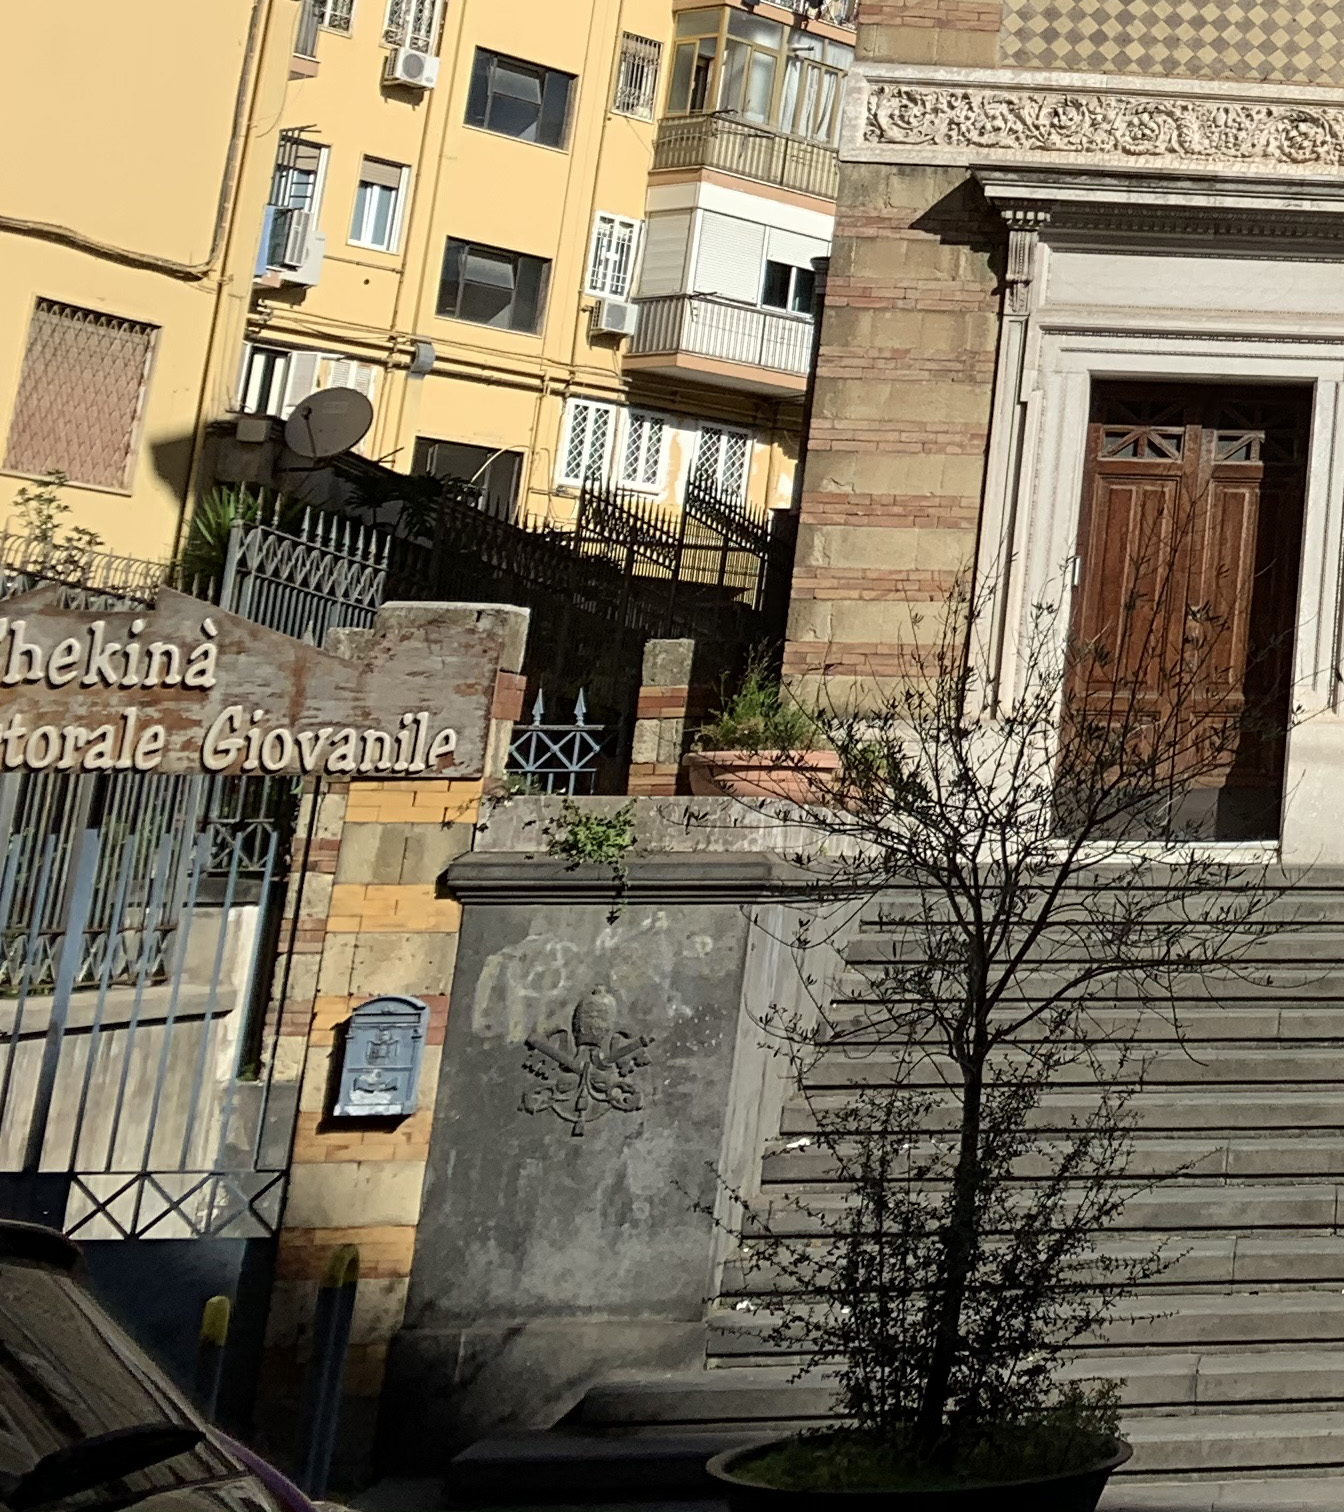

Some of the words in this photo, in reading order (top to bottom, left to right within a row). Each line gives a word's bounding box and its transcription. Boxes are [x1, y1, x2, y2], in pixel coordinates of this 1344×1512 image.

[0, 617, 218, 688] hekinà
[0, 706, 165, 771] torale
[202, 705, 457, 772] Giovanile
